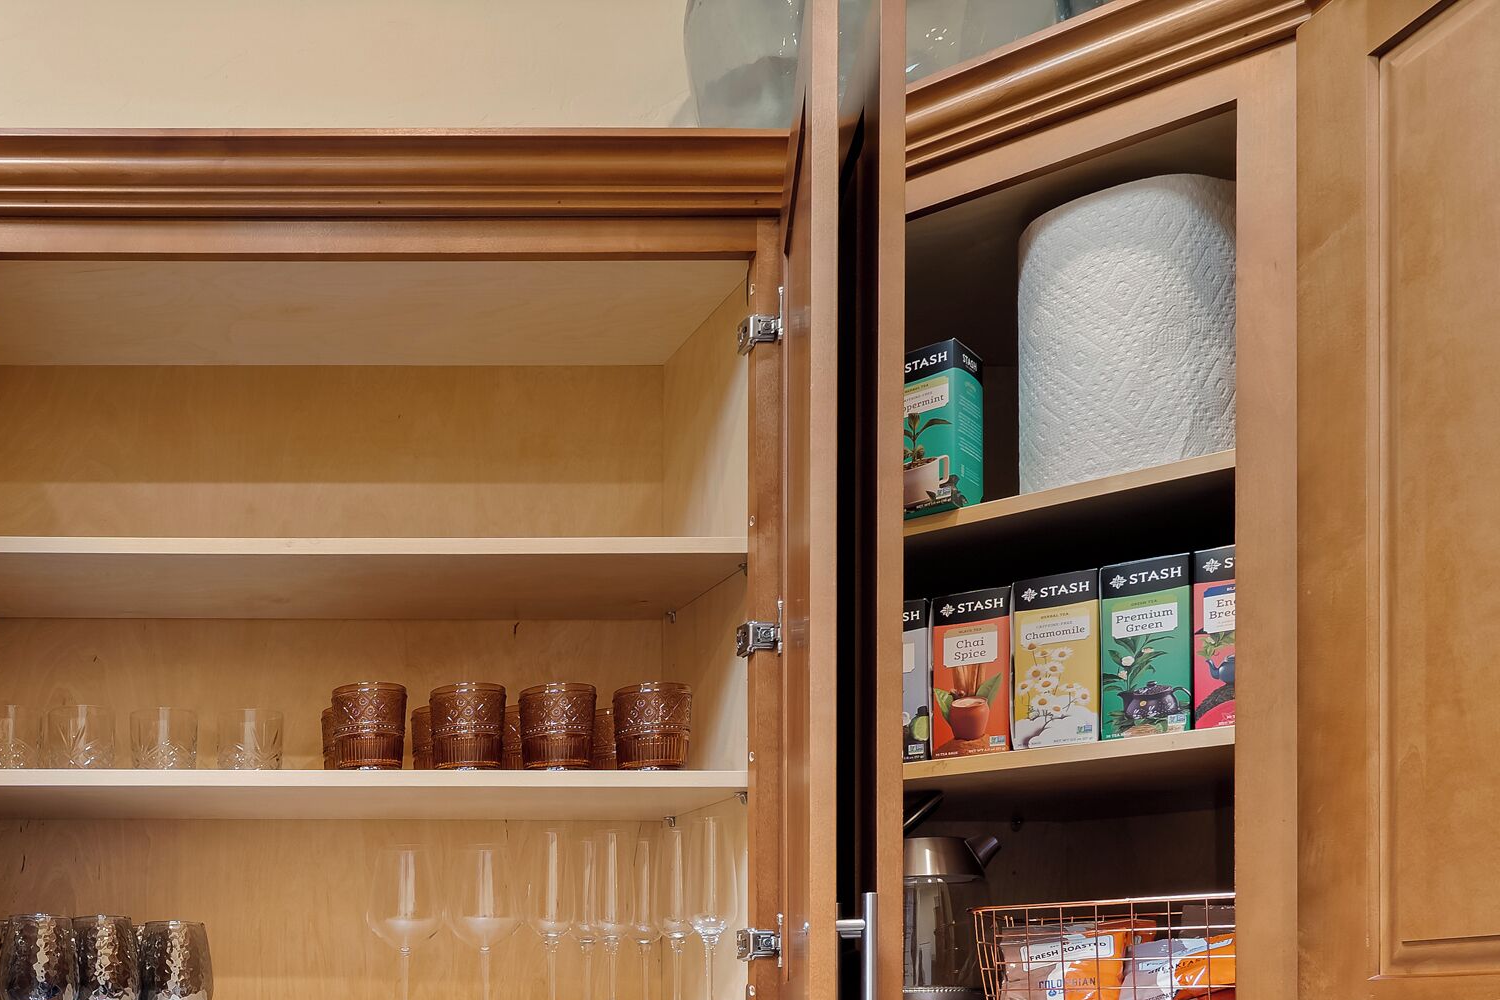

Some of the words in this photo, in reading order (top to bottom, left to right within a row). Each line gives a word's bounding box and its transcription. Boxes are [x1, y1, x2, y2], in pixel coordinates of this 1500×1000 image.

[904, 351, 948, 374] STASH
[904, 394, 944, 412] permint
[1129, 565, 1182, 585] STASH
[1040, 580, 1090, 598] STASH
[957, 597, 1004, 614] STASH
[1115, 608, 1174, 624] Premium
[1025, 625, 1085, 641] Chamomile
[1125, 620, 1163, 633] Green
[956, 636, 985, 649] Chai
[953, 649, 987, 661] Spice
[1029, 949, 1059, 961] FRESH
[1038, 977, 1096, 989] COLOBIAN
